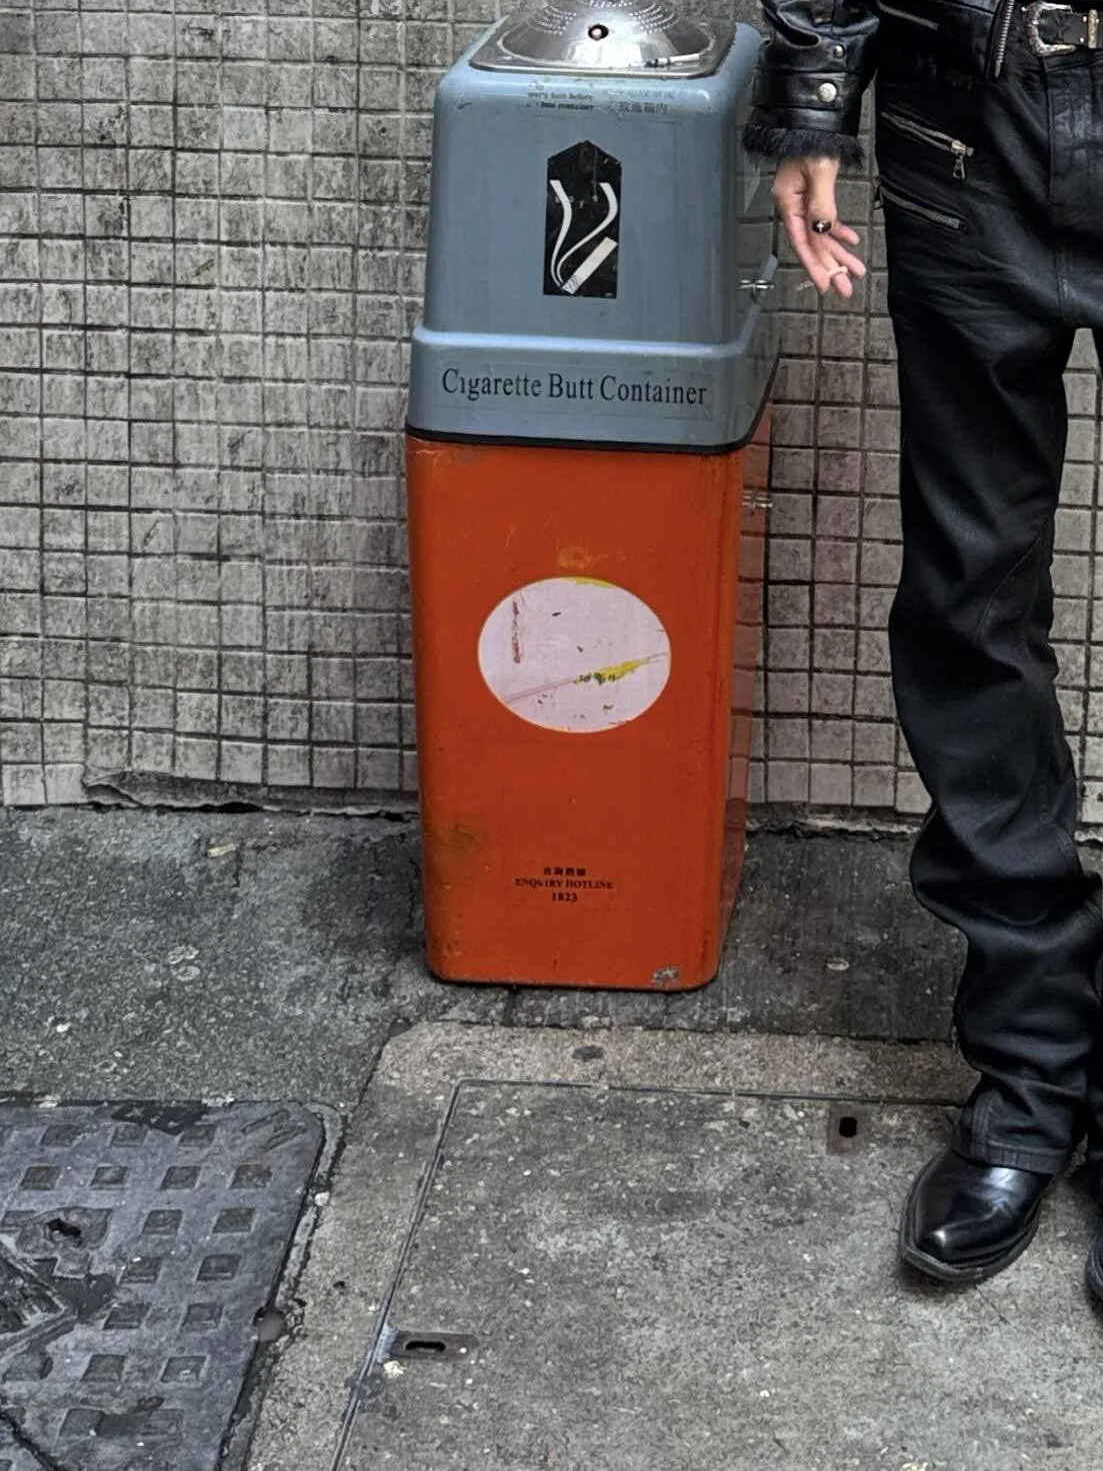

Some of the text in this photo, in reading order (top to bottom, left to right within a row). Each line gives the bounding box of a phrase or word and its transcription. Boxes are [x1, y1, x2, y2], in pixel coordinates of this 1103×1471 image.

[442, 368, 708, 405] Cigarette Butt Container
[552, 891, 578, 903] 1823
